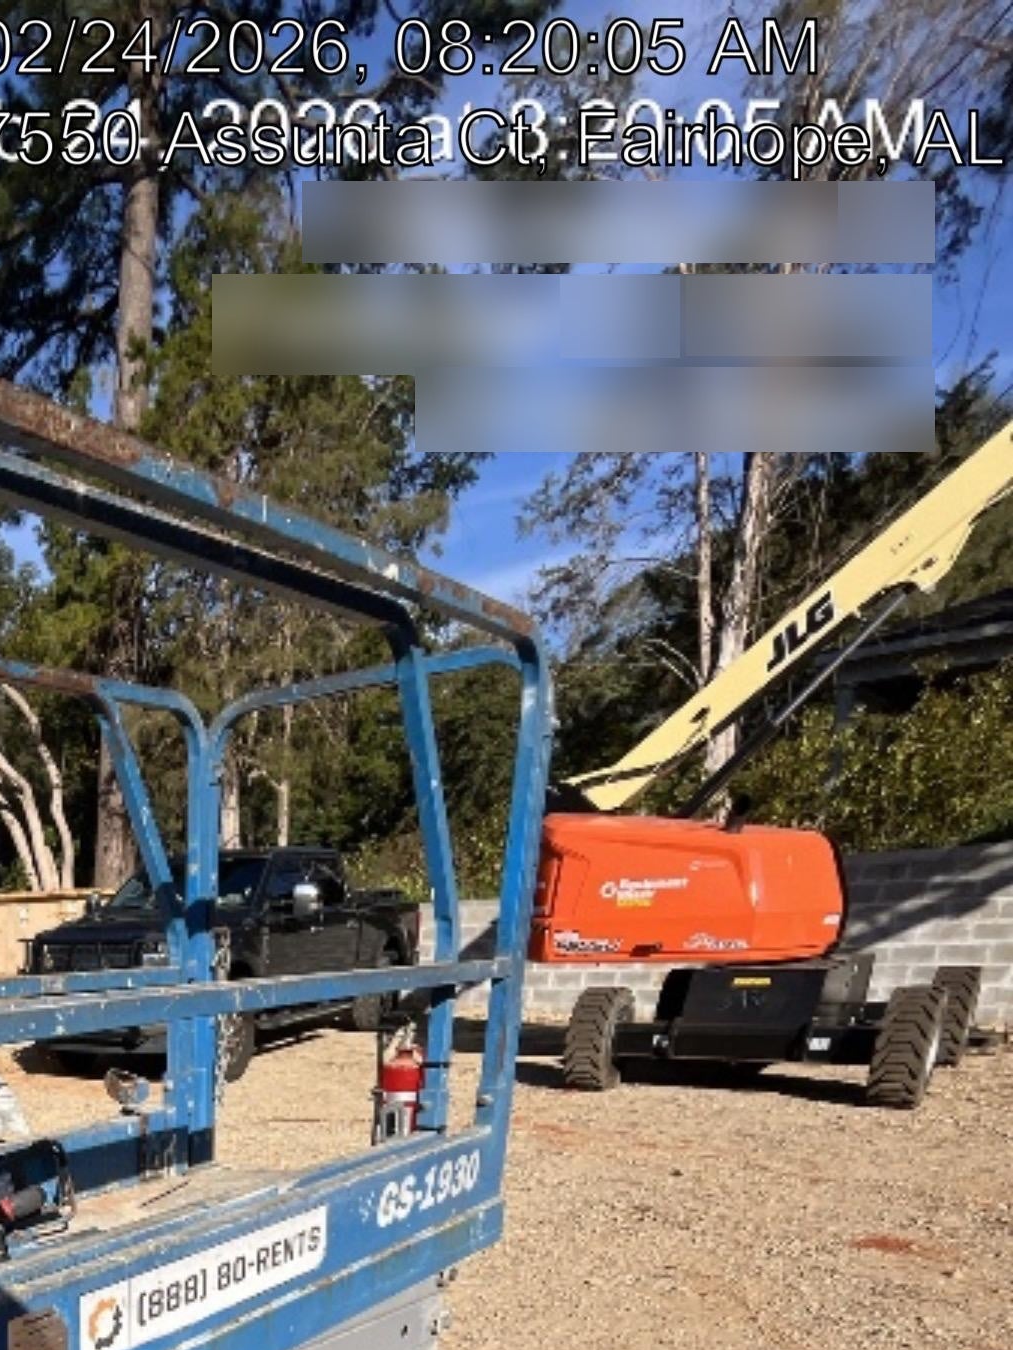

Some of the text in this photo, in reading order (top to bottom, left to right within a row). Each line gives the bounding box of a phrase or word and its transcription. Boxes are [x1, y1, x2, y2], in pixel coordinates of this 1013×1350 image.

[767, 589, 834, 672] JLG
[377, 1148, 480, 1228] GS-1930
[217, 1225, 322, 1291] 80-RENTS
